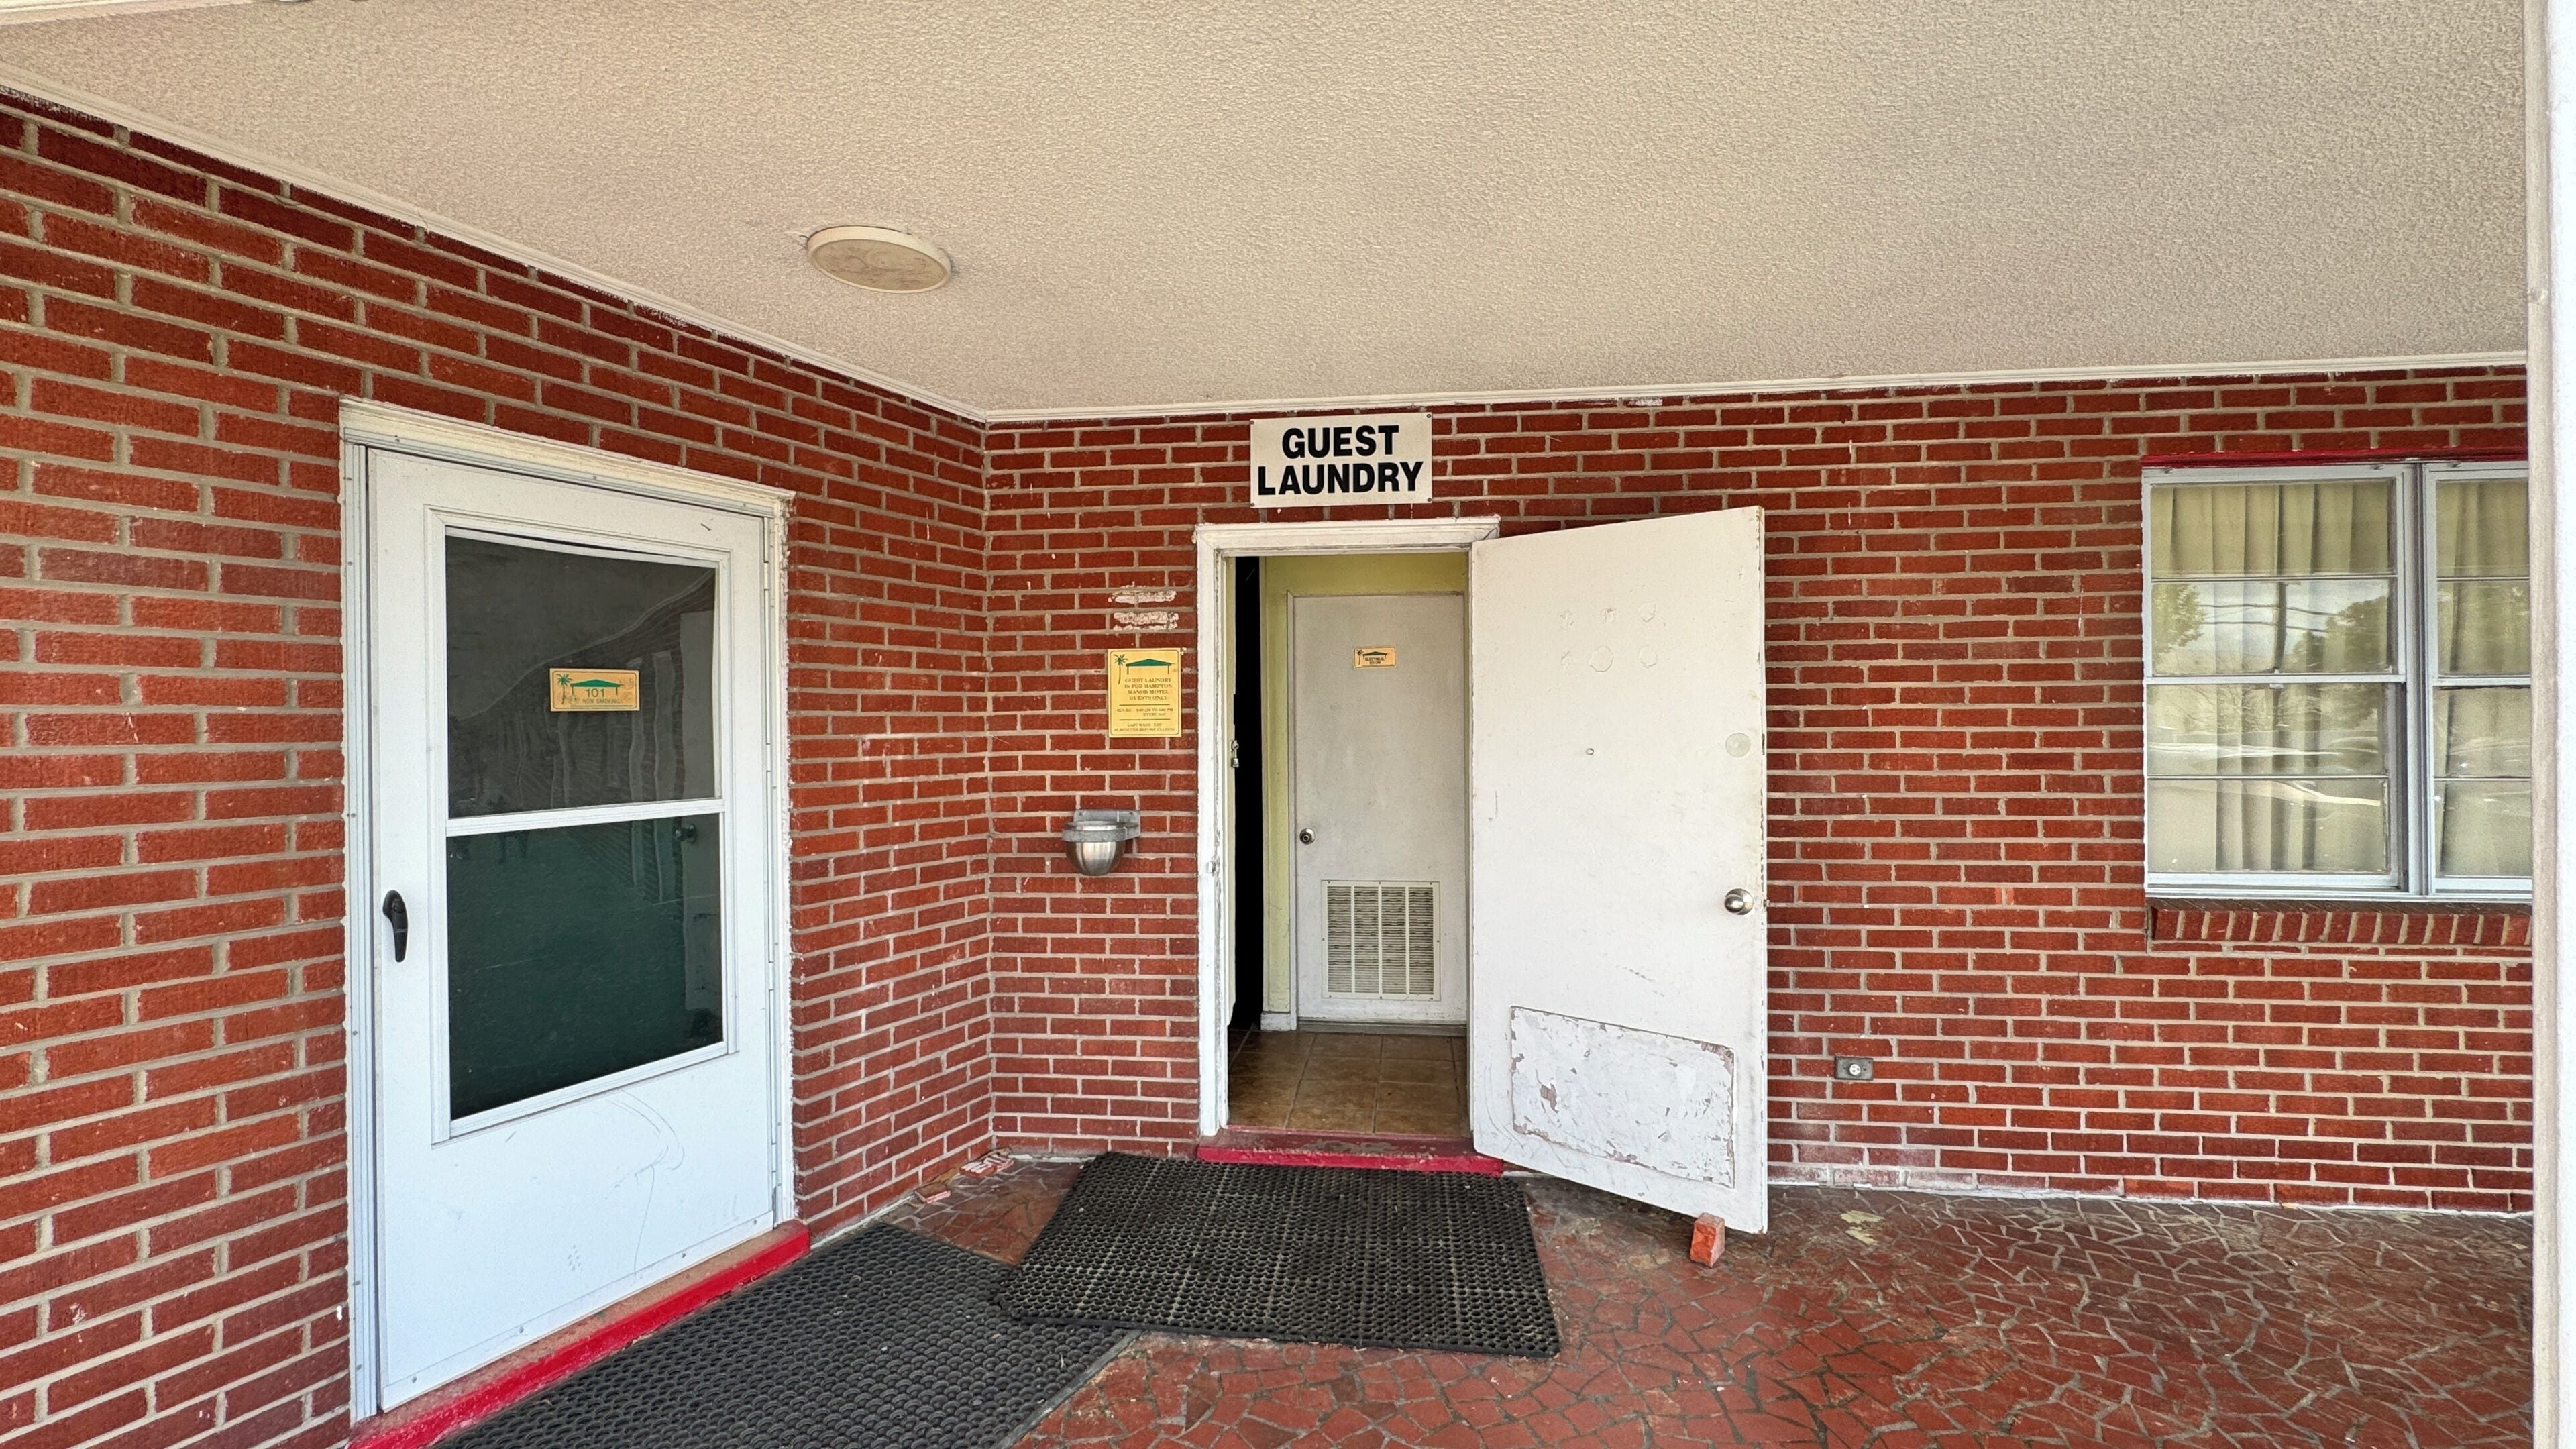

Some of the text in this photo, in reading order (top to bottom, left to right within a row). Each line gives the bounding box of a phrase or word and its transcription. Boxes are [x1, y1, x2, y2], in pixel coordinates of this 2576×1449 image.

[1282, 425, 1399, 459] GUEST
[1258, 461, 1424, 496] LAUNDRY
[585, 688, 604, 698] 101
